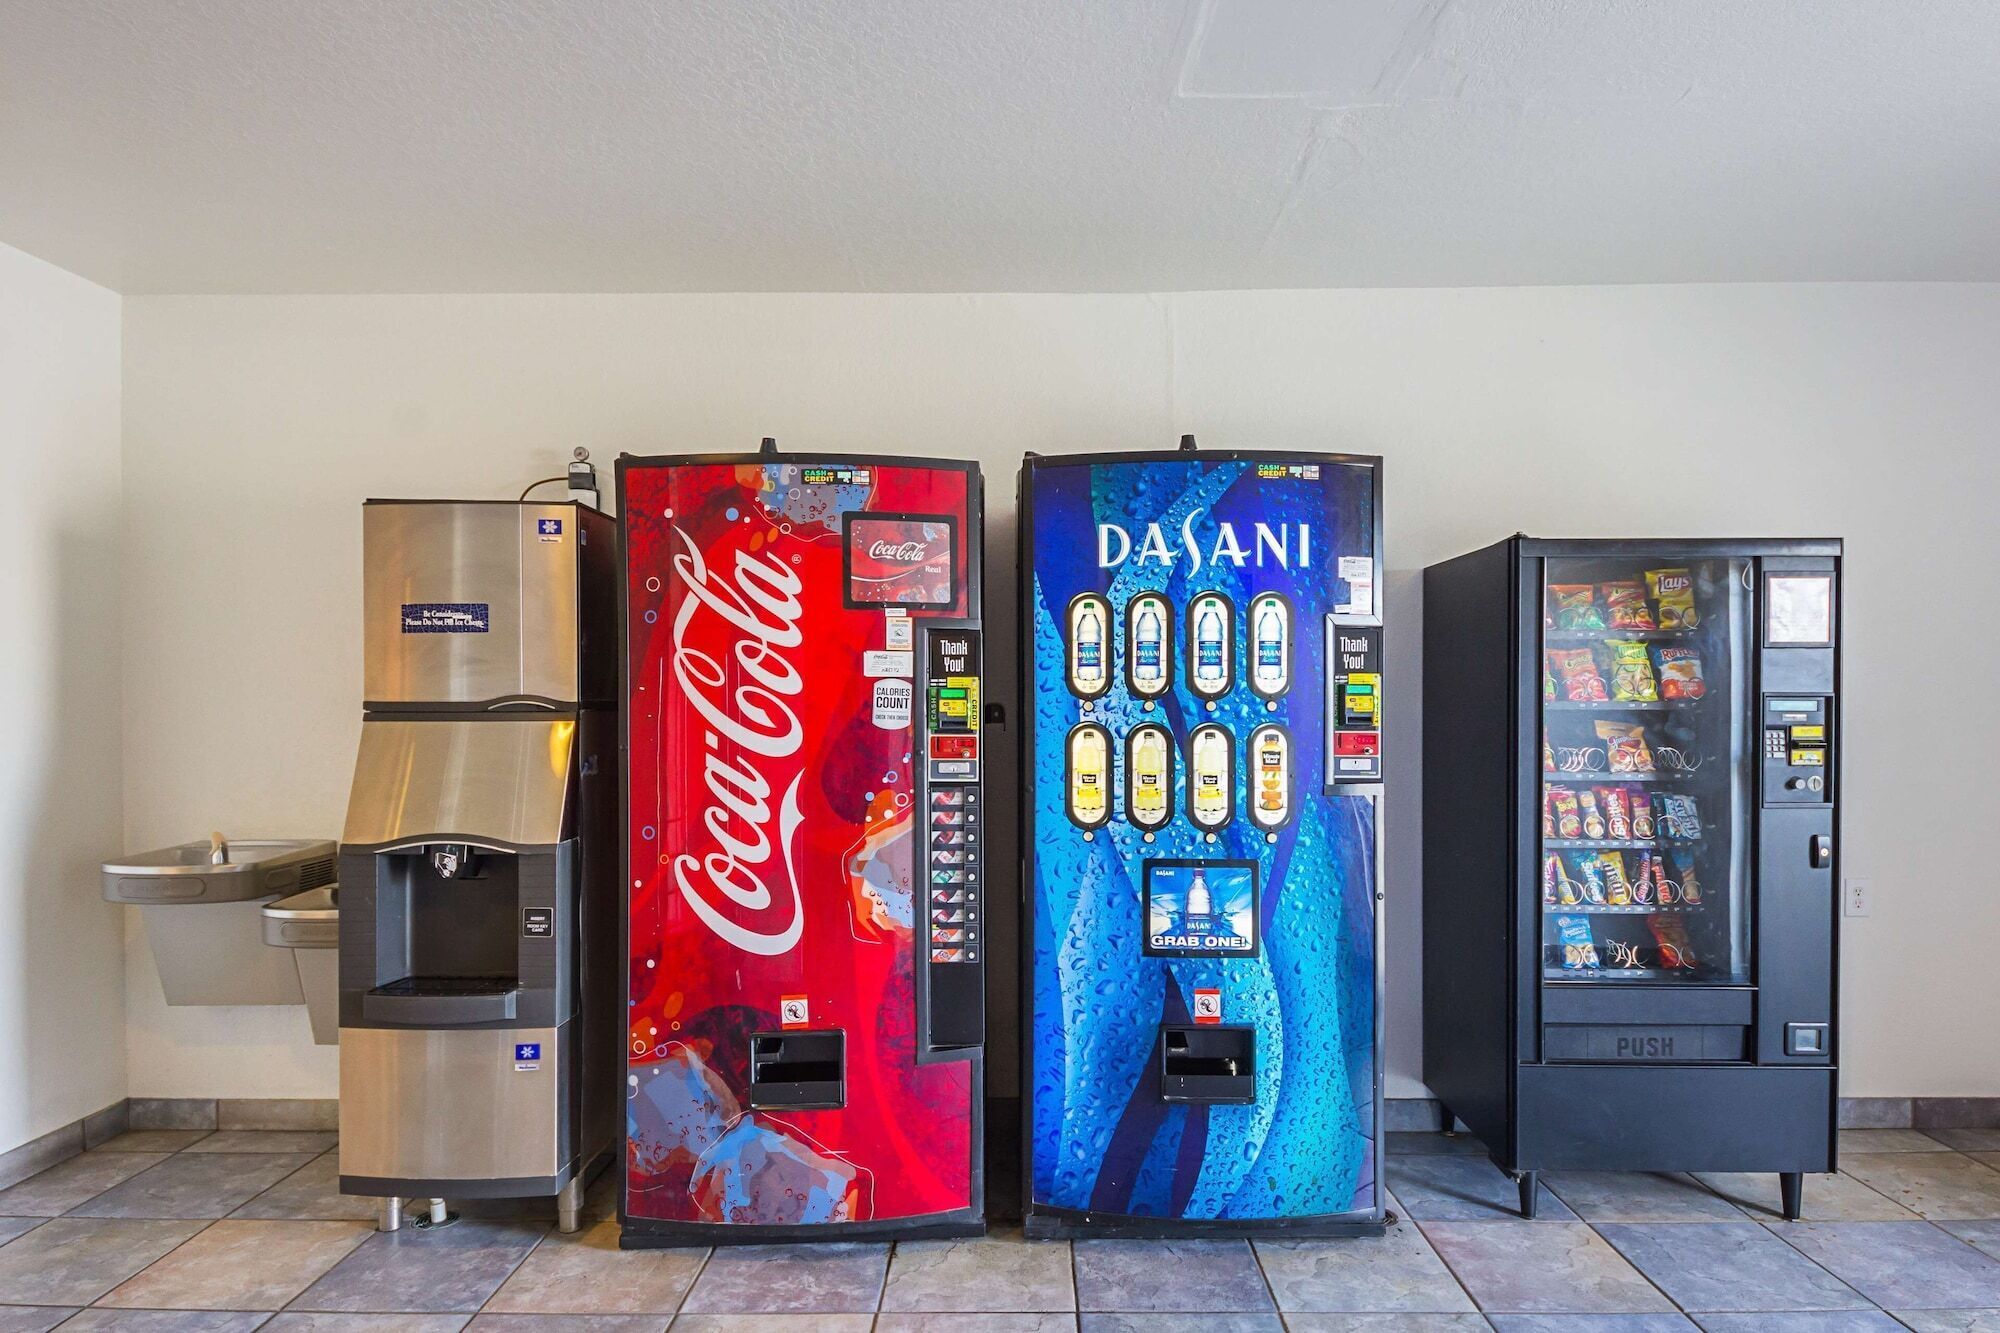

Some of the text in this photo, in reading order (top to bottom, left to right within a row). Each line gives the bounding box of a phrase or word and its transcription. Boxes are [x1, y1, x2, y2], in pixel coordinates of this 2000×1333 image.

[868, 539, 929, 561] Coca-Cola
[1098, 507, 1310, 579] DASANI
[925, 565, 941, 573] Real
[406, 618, 422, 626] Please
[423, 610, 431, 618] Be
[940, 640, 968, 656] Thank
[1340, 636, 1368, 652] Thank
[943, 657, 965, 673] You!
[1343, 653, 1364, 669] You!
[876, 687, 911, 697] CALORIES
[876, 697, 910, 709] COUNT
[673, 524, 806, 956] Coca-Cola
[1186, 922, 1211, 931] DASANI
[1151, 935, 1246, 948] GRAB ONE!
[1616, 1037, 1674, 1057] PUSH
